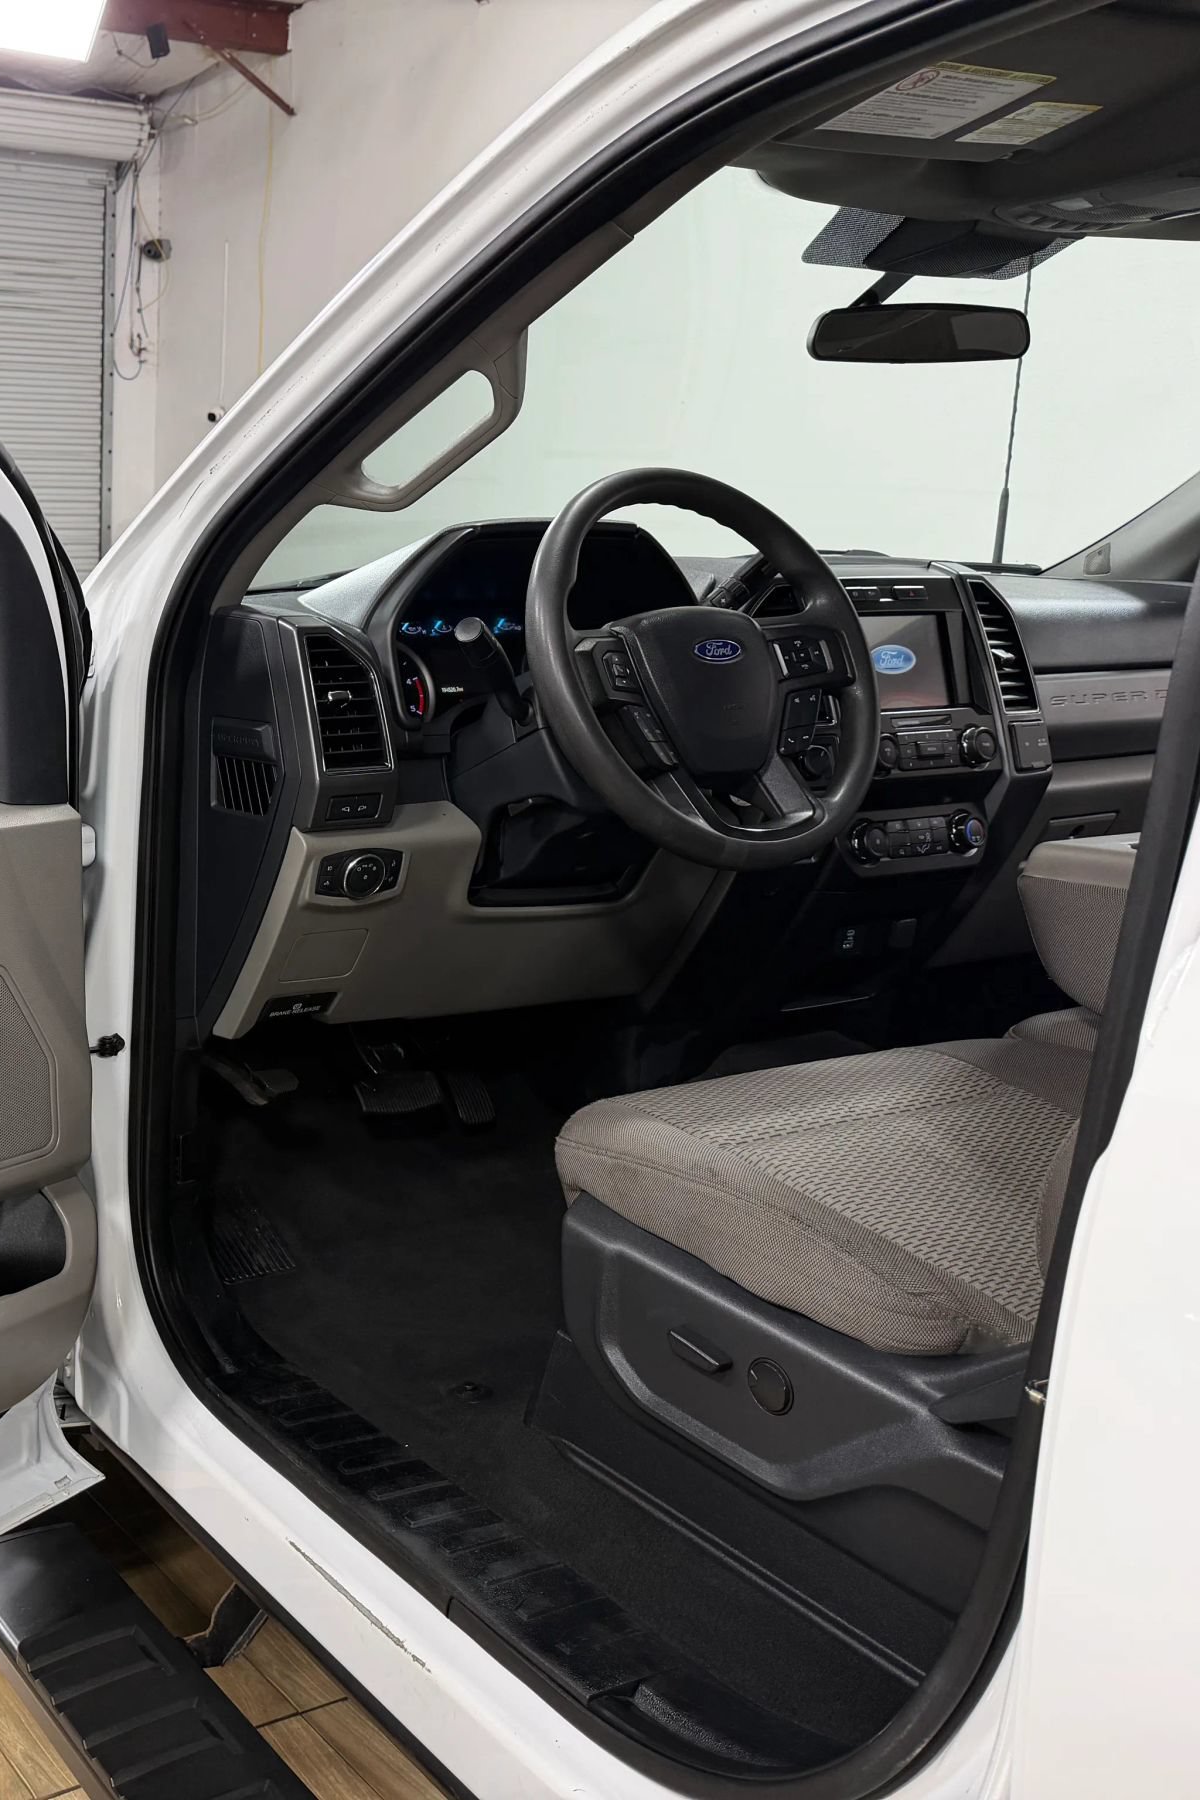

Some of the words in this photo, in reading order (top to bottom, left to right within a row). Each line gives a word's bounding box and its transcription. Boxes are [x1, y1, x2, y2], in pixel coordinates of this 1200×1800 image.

[705, 642, 733, 657] Ford
[878, 651, 905, 667] Ford
[1050, 690, 1148, 706] SUPER
[269, 1009, 292, 1017] BRAKE
[292, 1005, 321, 1014] RELEASE
